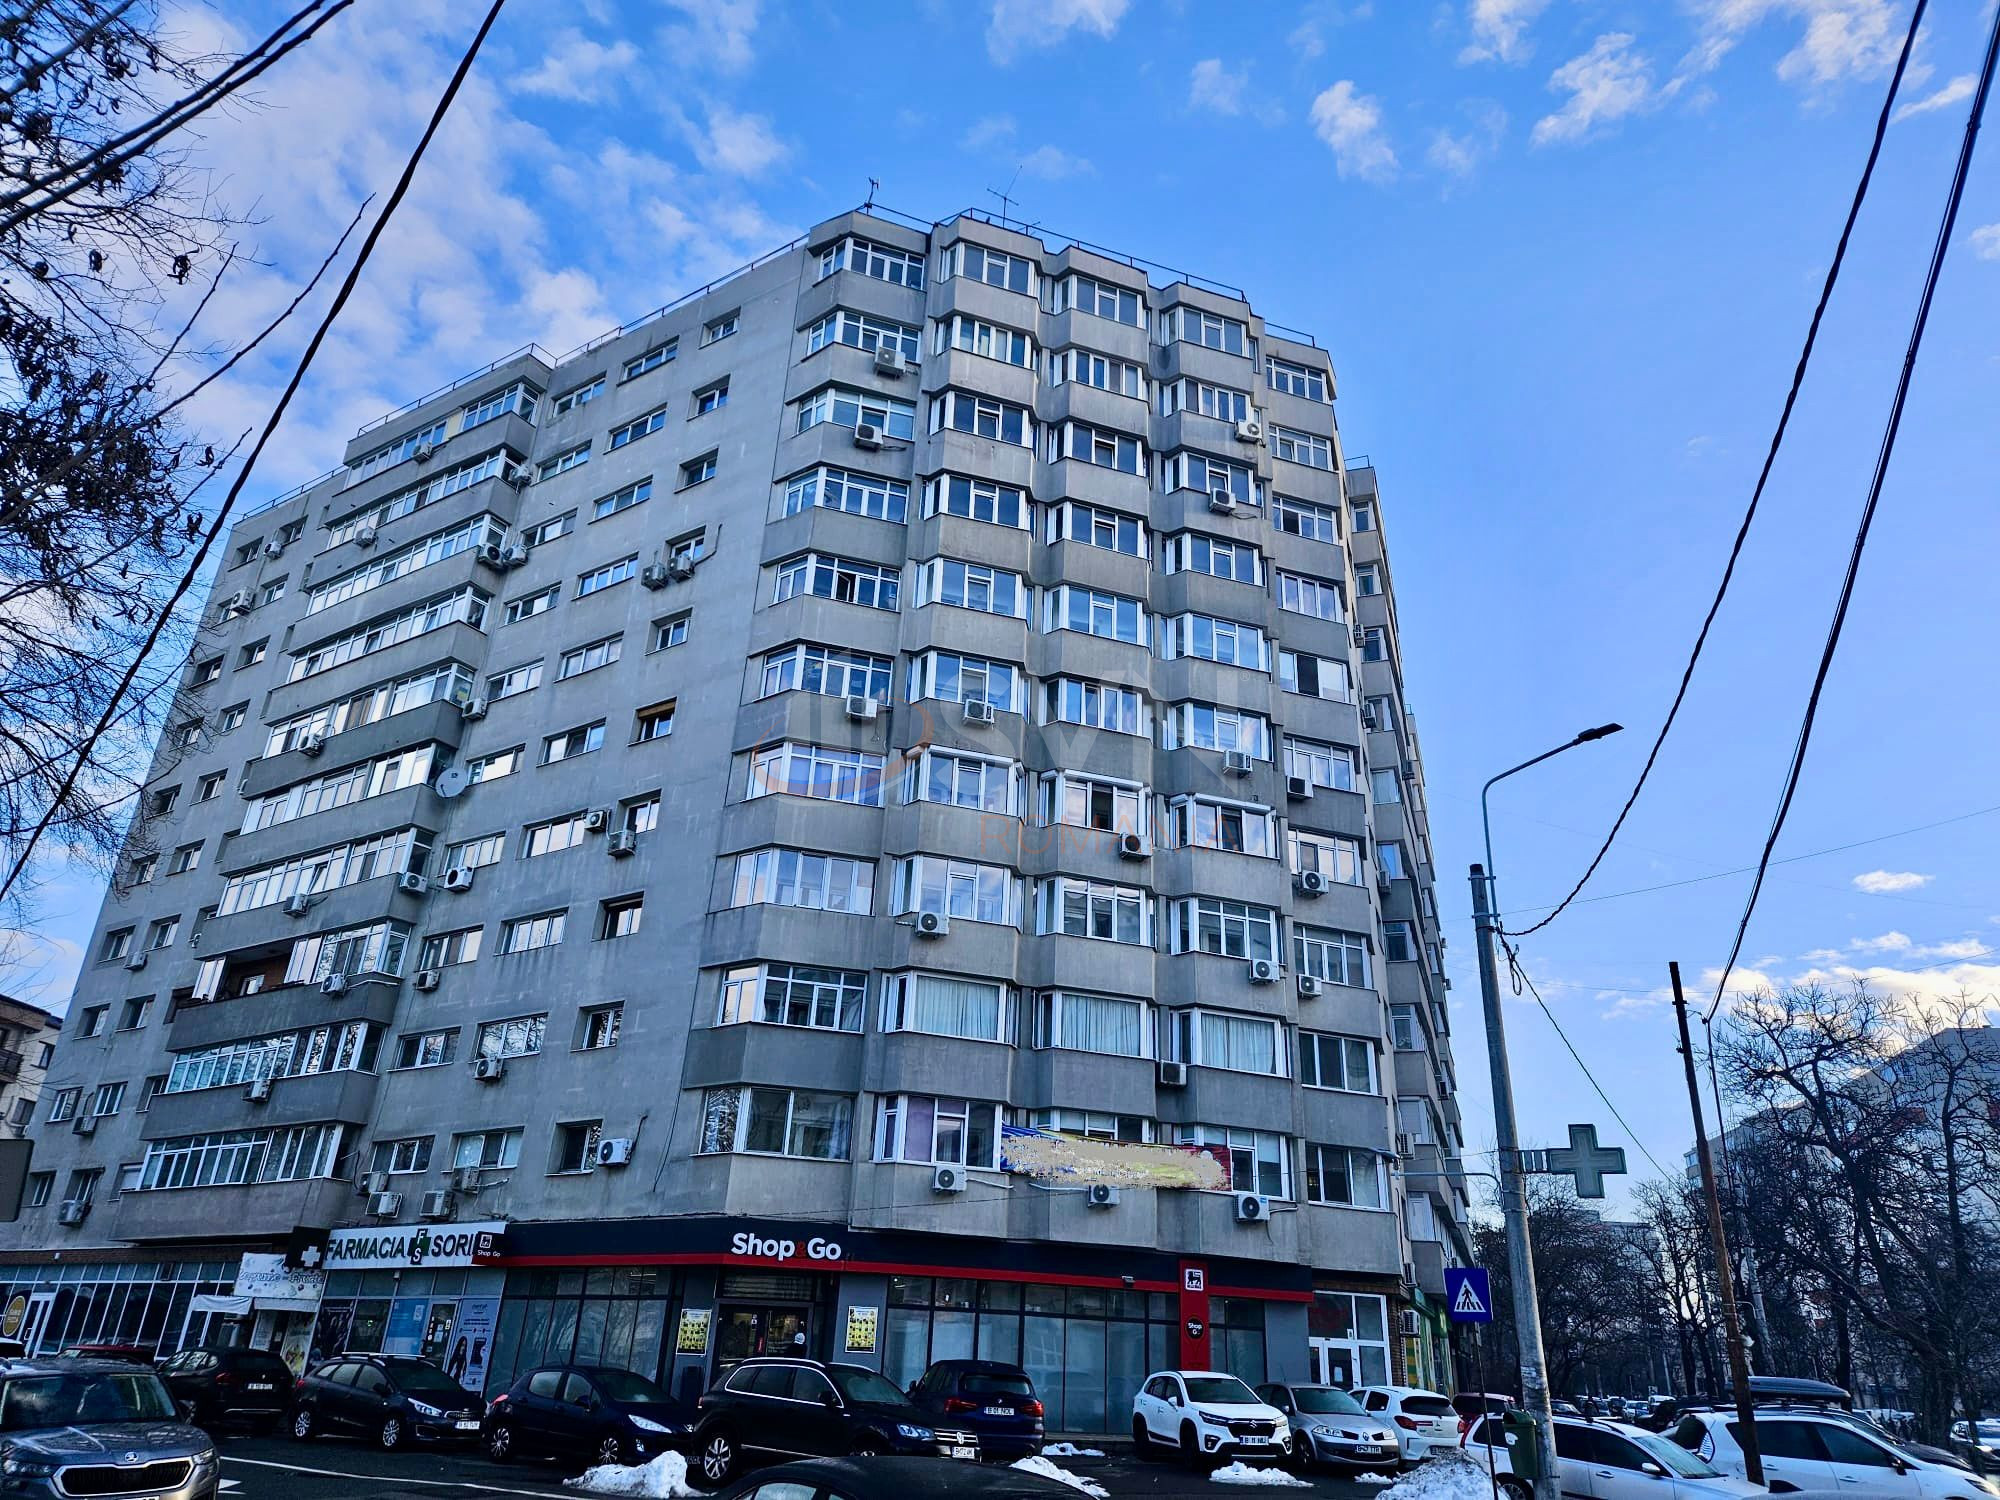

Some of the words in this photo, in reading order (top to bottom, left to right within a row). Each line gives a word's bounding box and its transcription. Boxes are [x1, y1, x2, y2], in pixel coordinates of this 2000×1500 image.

[325, 1235, 406, 1260] FARMACIA
[731, 1232, 796, 1261] Shop
[807, 1237, 842, 1260] Go
